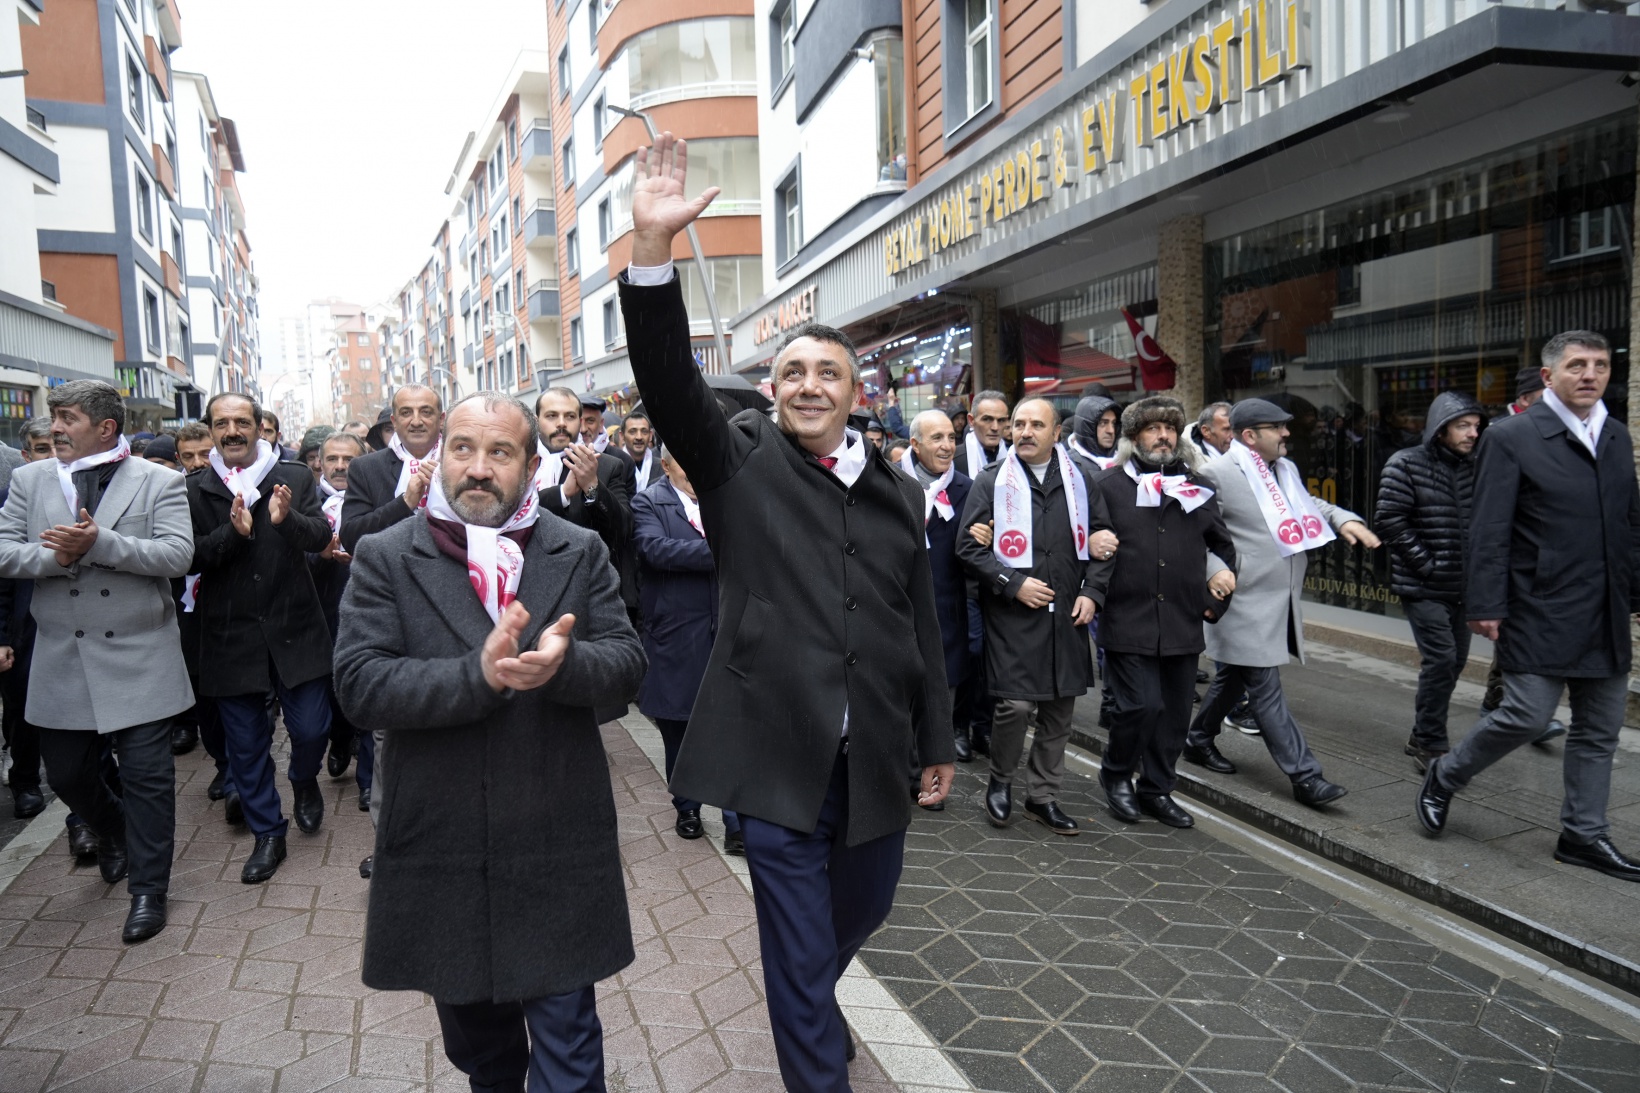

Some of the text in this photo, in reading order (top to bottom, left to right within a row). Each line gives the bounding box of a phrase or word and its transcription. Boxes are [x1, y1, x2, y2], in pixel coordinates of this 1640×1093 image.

[885, 215, 922, 277] BEYAZ
[929, 184, 974, 255] HOME
[981, 139, 1043, 228] PERDE
[1054, 125, 1066, 188] &
[1082, 90, 1117, 175] EV
[778, 285, 816, 333] MARKET
[1250, 449, 1287, 515] VEDAT SONE
[1319, 577, 1358, 597] DUVAR
[1360, 584, 1402, 604] KAĞID
